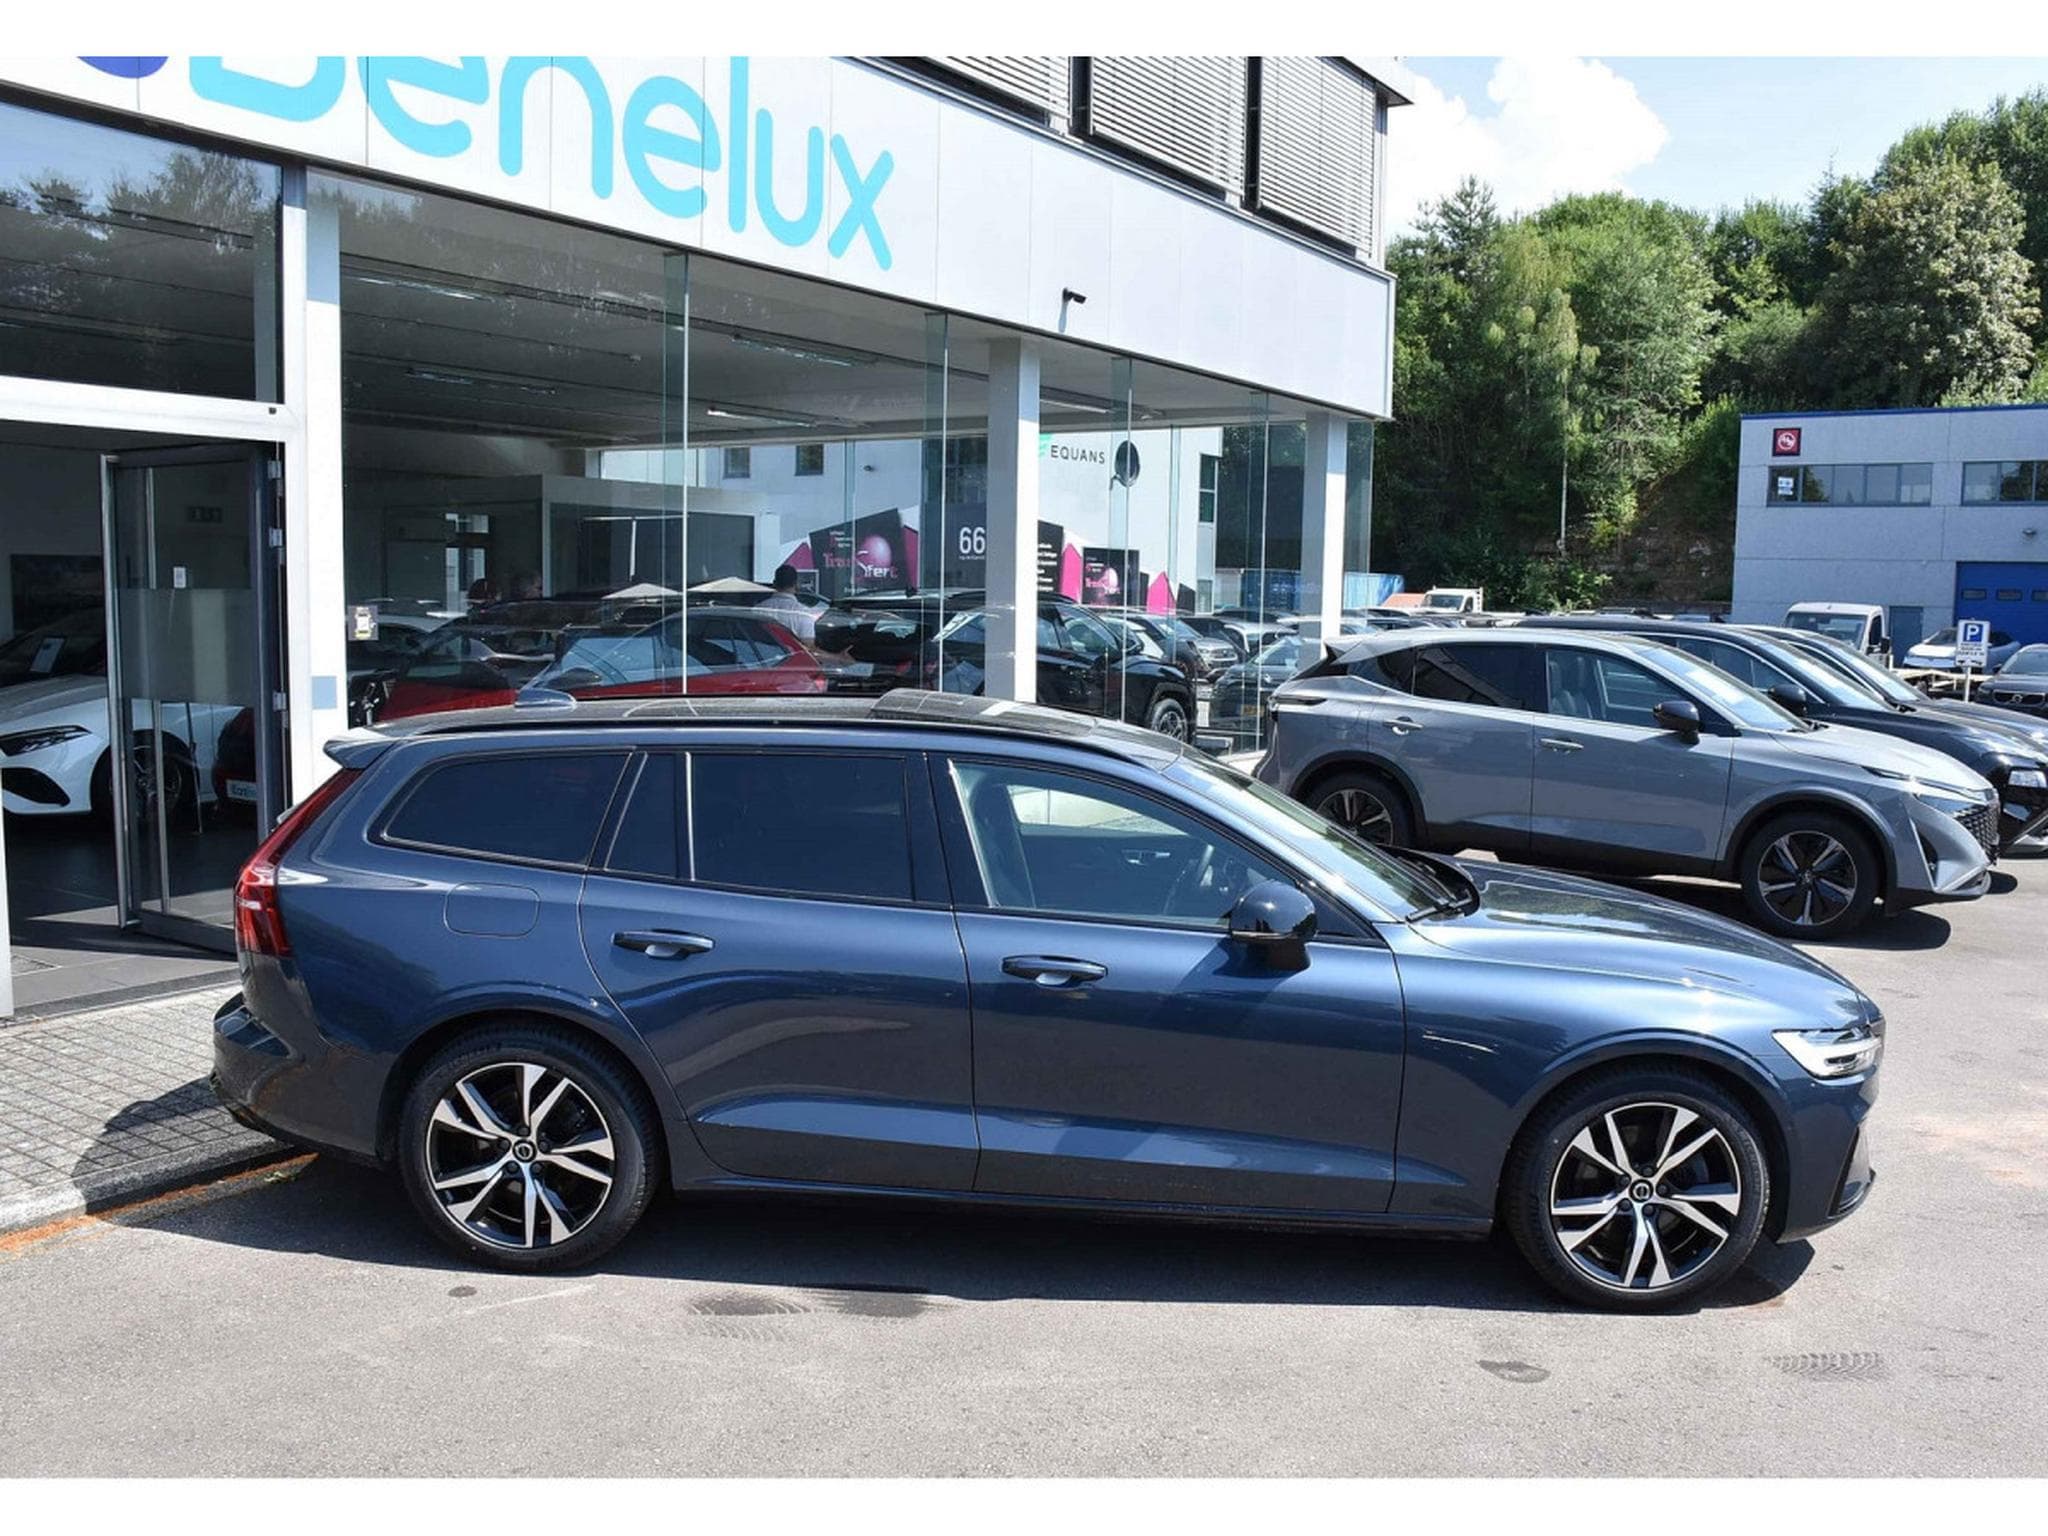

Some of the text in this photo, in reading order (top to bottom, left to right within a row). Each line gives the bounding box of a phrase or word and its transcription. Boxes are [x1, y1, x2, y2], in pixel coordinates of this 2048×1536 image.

[1050, 444, 1106, 464] EQUANS
[959, 526, 986, 554] 66
[1966, 624, 1980, 641] P
